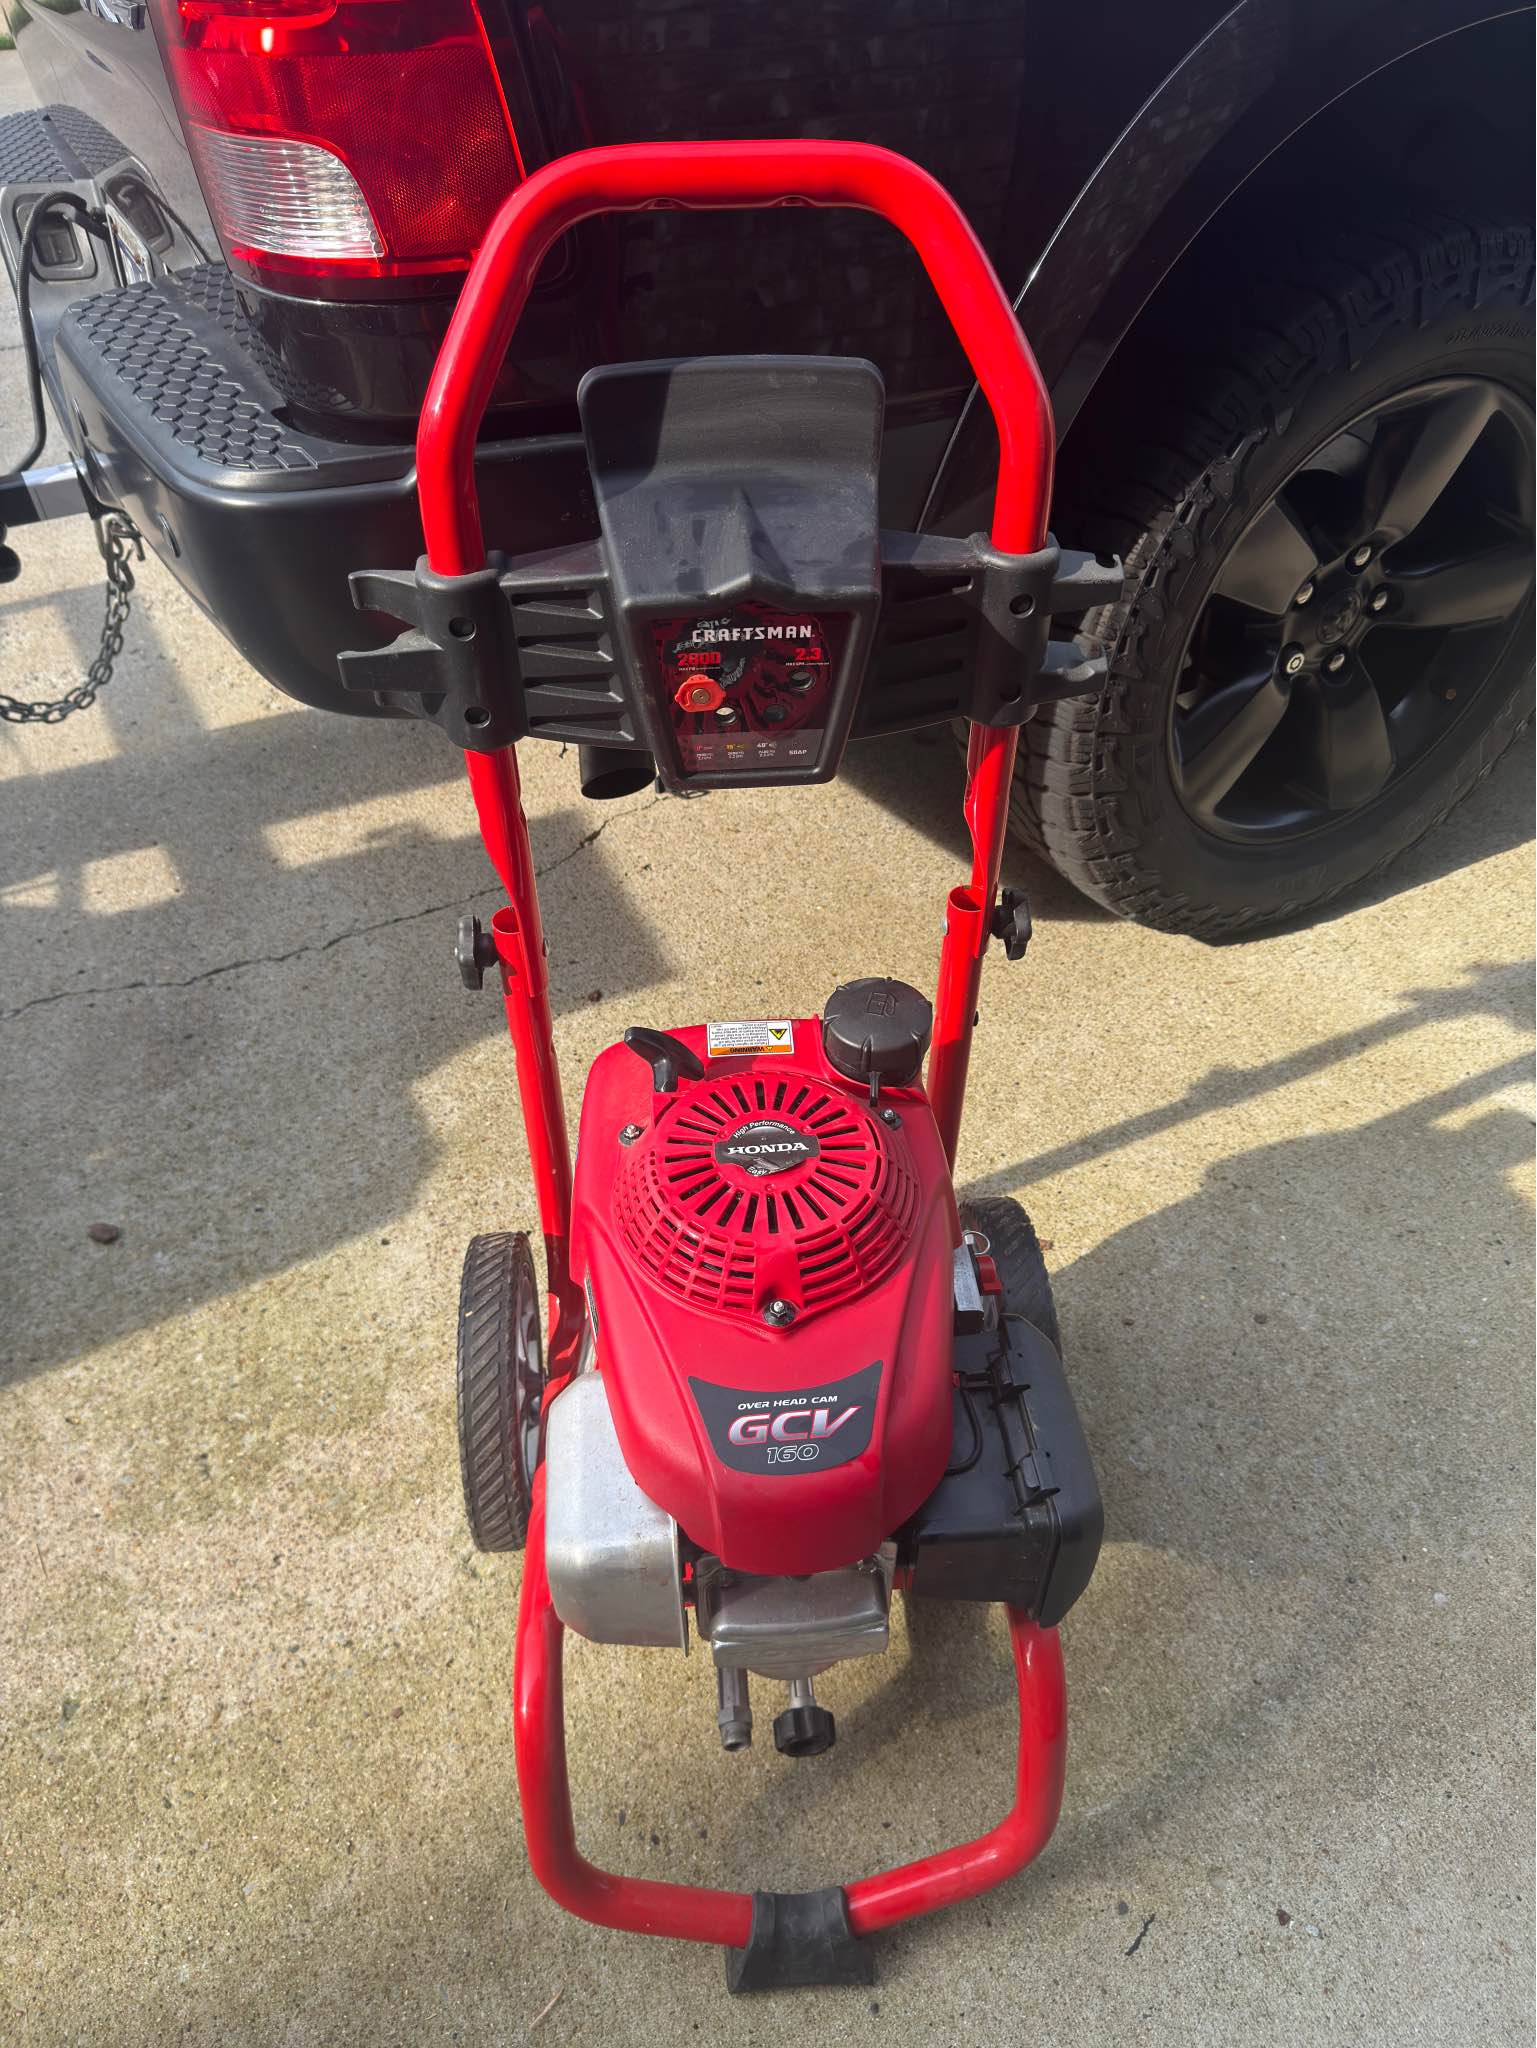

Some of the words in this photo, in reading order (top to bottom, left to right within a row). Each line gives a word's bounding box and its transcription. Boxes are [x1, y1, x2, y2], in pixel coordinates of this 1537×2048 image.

[692, 625, 812, 643] CRAFTSMAN
[675, 651, 721, 667] 2800
[794, 647, 822, 661] 2.3
[733, 1127, 749, 1139] High
[749, 1120, 796, 1135] Performance
[727, 1142, 810, 1155] HONDA
[737, 1401, 770, 1411] OVER
[773, 1398, 807, 1408] HEAD
[811, 1395, 838, 1404] CAM
[728, 1405, 863, 1446] GCV
[767, 1443, 820, 1464] 160
